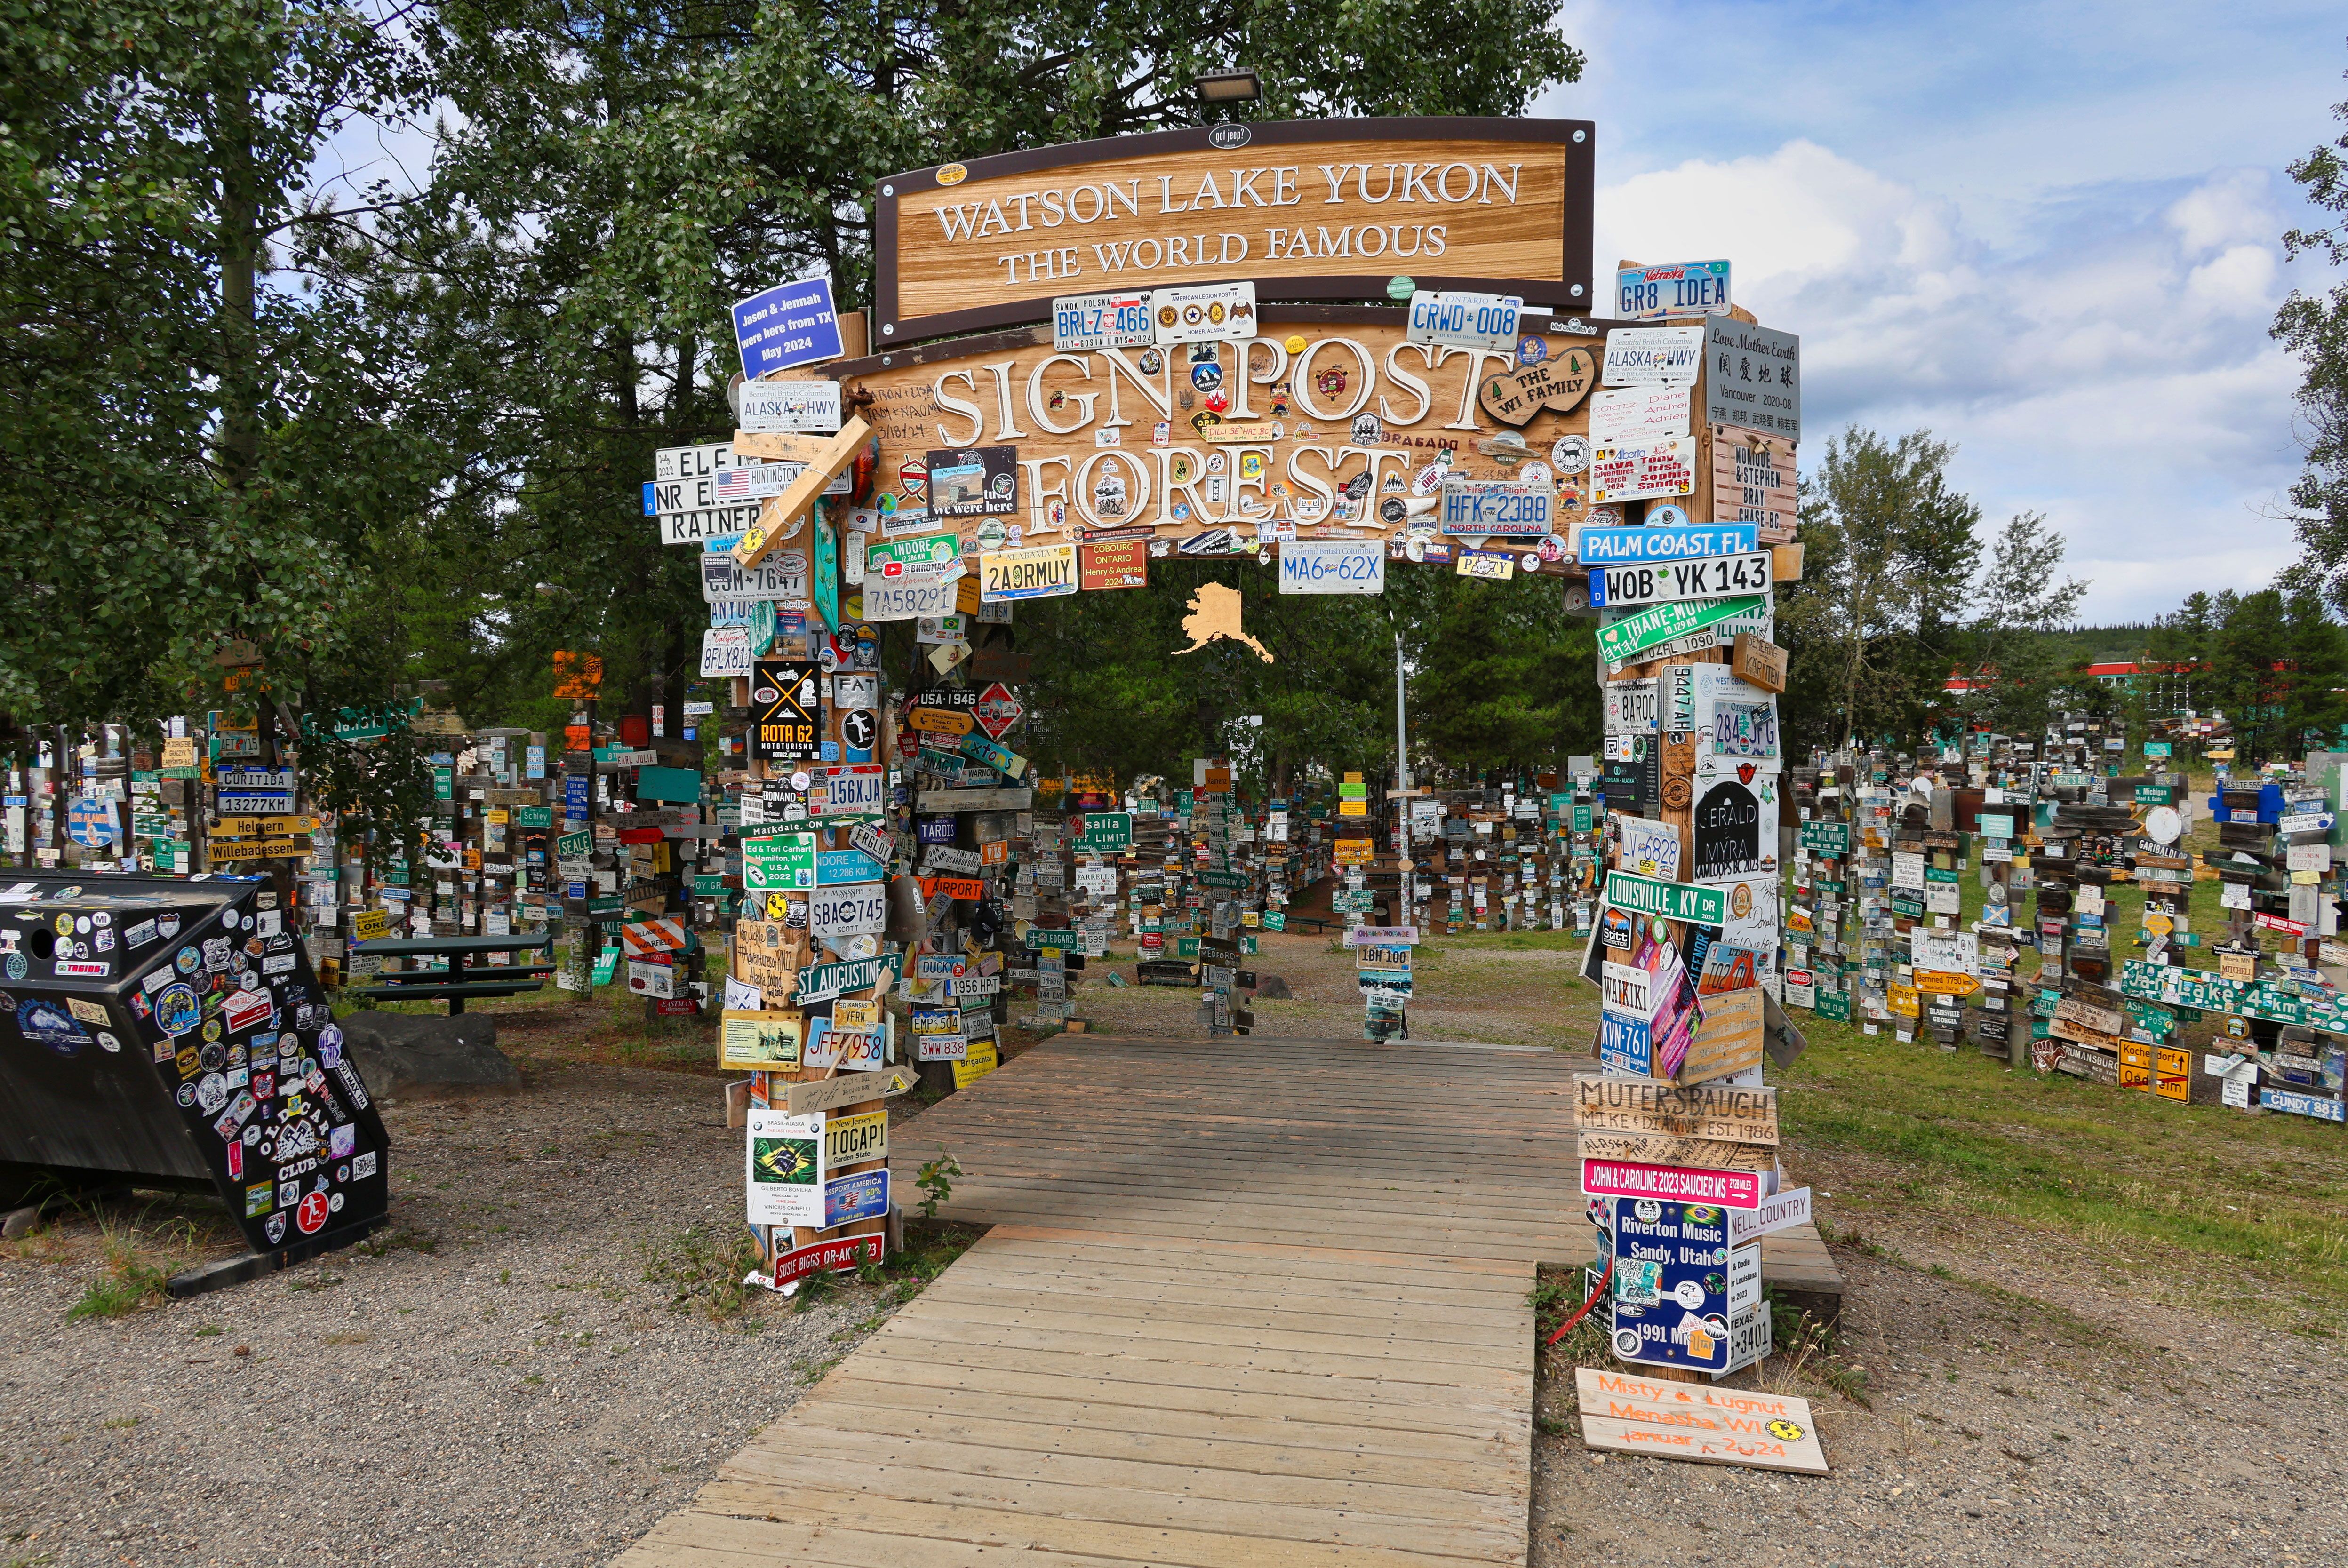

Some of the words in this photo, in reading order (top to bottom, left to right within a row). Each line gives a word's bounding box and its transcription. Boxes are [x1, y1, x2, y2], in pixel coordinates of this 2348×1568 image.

[1215, 131, 1226, 141] got
[1228, 129, 1244, 142] jeep?
[933, 179, 1141, 242] WATSON
[1157, 167, 1301, 214] LAKE
[1318, 163, 1522, 205] YUKON
[998, 247, 1082, 285] THE
[1091, 233, 1249, 273] WORLD
[1265, 225, 1447, 259] FAMOUS
[1643, 267, 1685, 283] Nebraska
[1446, 295, 1489, 304] ONTARIO
[1621, 283, 1658, 312] GR8
[1674, 278, 1725, 308] IDEA
[742, 310, 768, 327] Jason
[769, 304, 778, 315] &
[780, 293, 821, 312] Jennah
[1056, 302, 1078, 311] SANOK
[1084, 298, 1110, 307] POLSKA
[1058, 309, 1103, 337] BRLZ
[1116, 306, 1149, 332] 466
[1414, 302, 1463, 331] CRWD
[1477, 307, 1515, 335] 008
[741, 334, 762, 350] were
[764, 324, 786, 340] here
[787, 317, 815, 334] from
[816, 311, 833, 324] TX
[761, 346, 782, 361] May
[783, 337, 813, 355] 2024
[1712, 328, 1734, 347] Love
[1736, 334, 1770, 355] Mother
[1772, 342, 1796, 361] Earth
[1516, 368, 1552, 389] THE
[934, 343, 1179, 449] SIGN
[1222, 337, 1516, 431] POST
[1499, 402, 1524, 415] WI
[1527, 378, 1584, 403] FAMILY
[1720, 384, 1756, 403] Vancouver
[1764, 395, 1791, 409] 2020-08
[745, 401, 790, 416] ALASKA
[807, 400, 835, 414] HWY
[1382, 432, 1458, 451] BRAGADO
[1017, 445, 1410, 537] FOREST
[1094, 544, 1133, 553] COBOURG
[1589, 536, 1642, 557] PALM
[1647, 533, 1716, 556] COAST,
[1721, 532, 1748, 554] FL
[1095, 554, 1132, 563] ONTARIO
[1606, 569, 1654, 601] WOB
[1674, 563, 1707, 595] YK
[1715, 557, 1766, 591] 143
[921, 693, 942, 705] USA
[948, 694, 975, 705] 1946
[761, 725, 791, 742] ROTA
[797, 725, 813, 742] 62
[618, 756, 633, 765] EARL
[224, 773, 284, 785] CURITIBA
[830, 778, 880, 804] 156XJA
[225, 799, 285, 811] 13277KM
[524, 812, 547, 821] Schley
[1699, 805, 1757, 828] GERALD
[238, 820, 284, 833] Helmern
[753, 823, 803, 836] Markdale,
[921, 823, 954, 838] TARDIS
[561, 836, 588, 855] SEALE
[1095, 834, 1125, 842] LIMIT
[1817, 831, 1845, 844] MILMINE
[212, 844, 293, 858] Willebadessen
[1337, 844, 1372, 853] Schlagsdorf
[1706, 839, 1748, 863] MYRA
[560, 865, 580, 874] Eitzumer
[1695, 860, 1732, 879] KAMLOOPS
[1733, 859, 1743, 872] BC
[1744, 857, 1759, 872] 2023
[1203, 876, 1237, 886] Grimshaw
[1611, 878, 1674, 915] LOUISVILLE,
[1679, 891, 1698, 916] KY
[1702, 899, 1716, 912] DR
[815, 902, 837, 926] SBA
[858, 899, 883, 922] 745
[632, 929, 657, 939] VILLAGE
[1050, 935, 1073, 943] EDGARS
[1914, 933, 1974, 952] BURLINGTON
[636, 938, 673, 950] WARFIELD
[1201, 950, 1235, 960] MEDFORD
[1362, 949, 1382, 962] 1BH
[1386, 951, 1406, 963] 100
[799, 971, 815, 995] ST
[819, 959, 882, 992] AUGUSTINE
[889, 957, 899, 969] FL
[1789, 974, 1809, 982] DANGER
[1917, 975, 1943, 983] Bernried
[2222, 965, 2253, 976] MITCHELL
[954, 979, 977, 994] 1956
[980, 978, 998, 991] HPT
[1604, 976, 1648, 1011] WAIKIKI
[1890, 987, 1914, 1000] Hemer
[1929, 1008, 1960, 1017] BLAIRSVILLE
[922, 1042, 941, 1055] 3WW
[943, 1042, 964, 1055] 838
[960, 1054, 992, 1067] Brigachtal
[1581, 1081, 1768, 1121] MUTERSBAUGH
[2271, 1095, 2311, 1113] CUNDY
[279, 1157, 318, 1181] CLUB
[1591, 1166, 1612, 1187] JOHN
[1613, 1172, 1618, 1184] &
[1618, 1170, 1658, 1191] CAROLINE
[1658, 1172, 1679, 1193] 2023
[1680, 1176, 1713, 1196] SAUCIER
[1715, 1179, 1726, 1199] MS
[1759, 1197, 1806, 1226] COUNTRY
[1622, 1217, 1678, 1238] Riverton
[1682, 1223, 1722, 1242] Music
[779, 1260, 796, 1279] SUSIE
[799, 1252, 820, 1270] BIGGS
[823, 1247, 851, 1263] OR-AK
[1630, 1242, 1674, 1265] Sandy,
[1680, 1248, 1713, 1266] Utah
[1599, 1375, 1664, 1401] Misty
[1675, 1392, 1693, 1402] &
[1706, 1390, 1787, 1416] Lugnut
